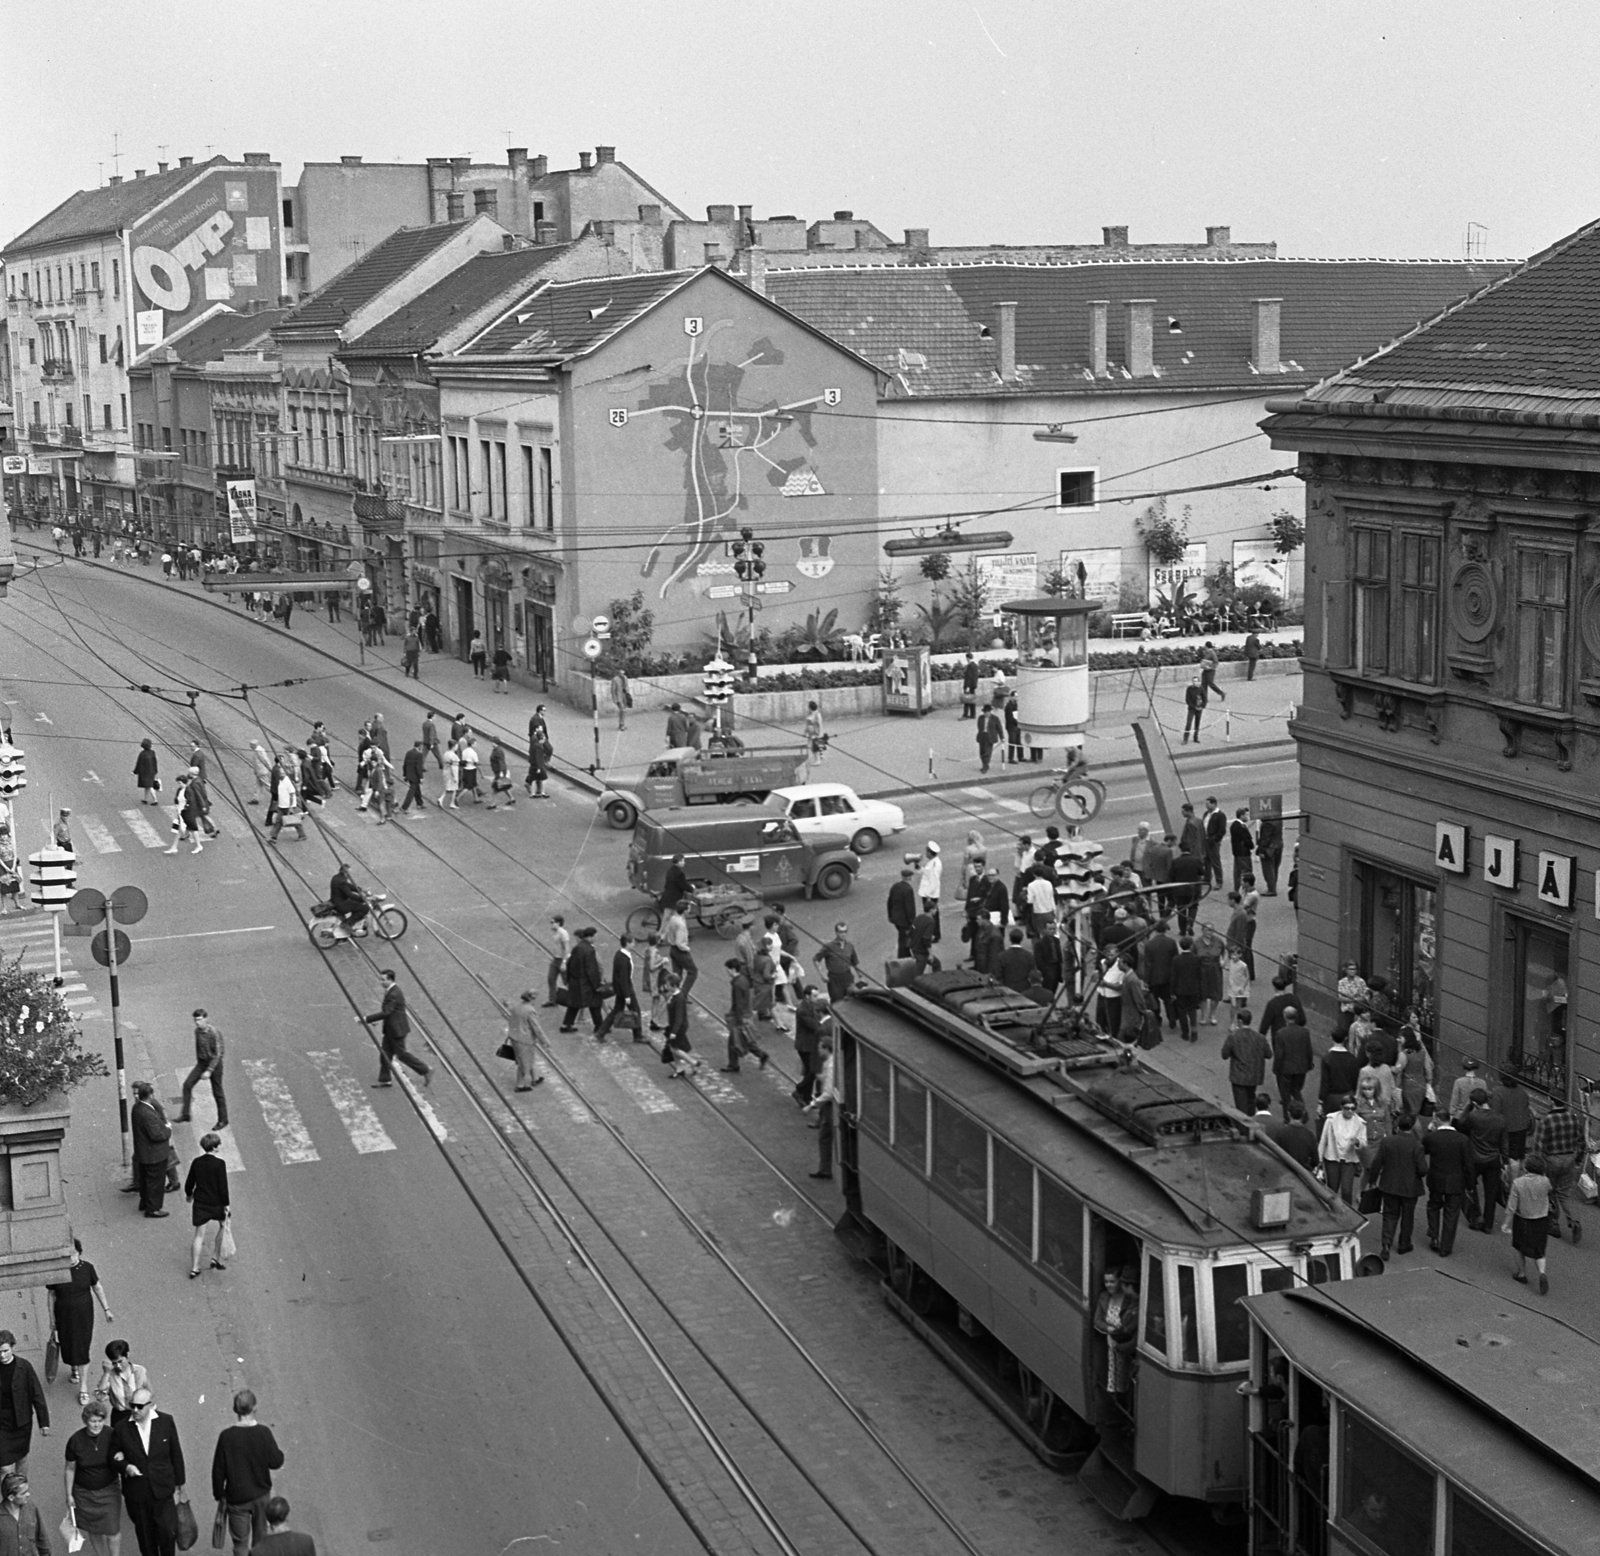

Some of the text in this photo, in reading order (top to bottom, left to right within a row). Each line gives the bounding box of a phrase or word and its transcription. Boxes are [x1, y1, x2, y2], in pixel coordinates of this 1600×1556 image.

[133, 210, 234, 312] OTP
[690, 319, 698, 334] 3
[829, 390, 837, 404] 3
[612, 410, 625, 423] 26
[1260, 798, 1272, 811] M
